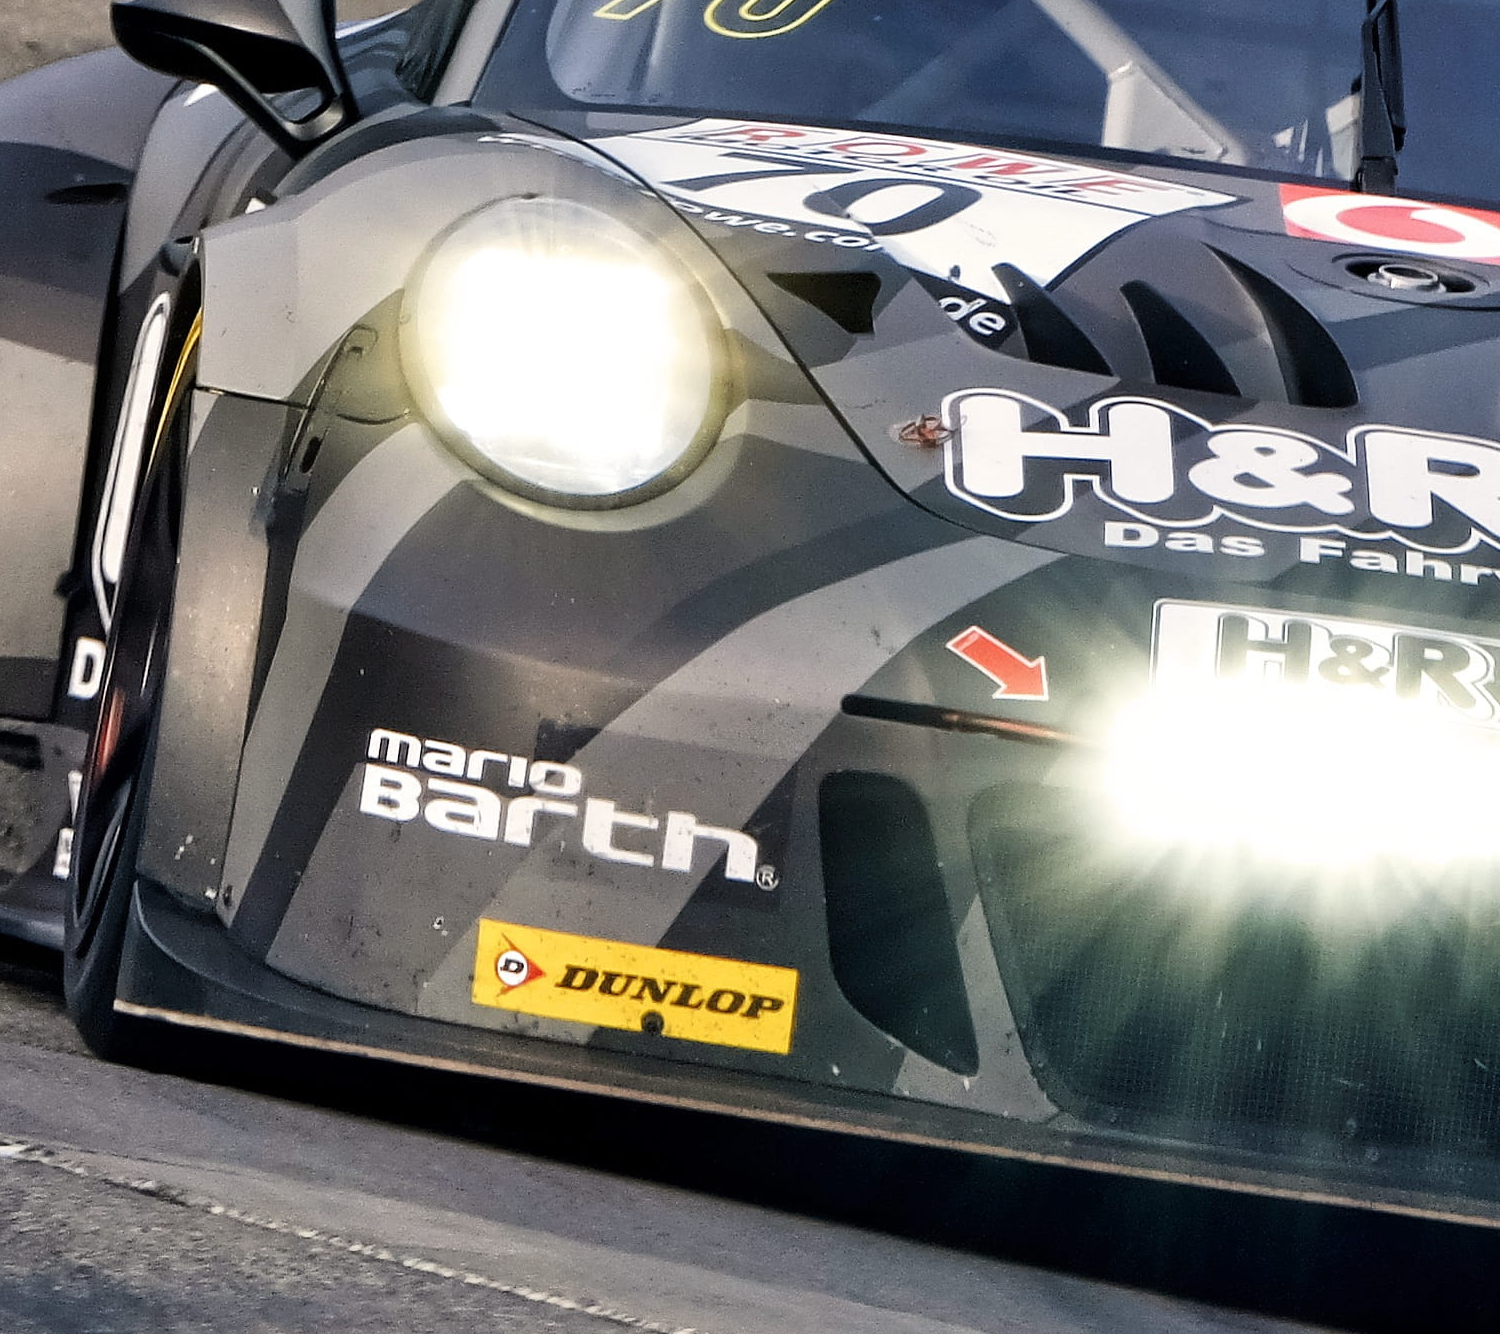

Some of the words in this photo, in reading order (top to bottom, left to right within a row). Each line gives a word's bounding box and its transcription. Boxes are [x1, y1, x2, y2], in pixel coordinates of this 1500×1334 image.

[660, 151, 981, 237] 70
[703, 128, 1172, 196] ROWE
[1103, 520, 1266, 559] Das
[367, 727, 582, 796] mario
[359, 762, 759, 883] Barth
[554, 963, 786, 1019] DUNLOP
